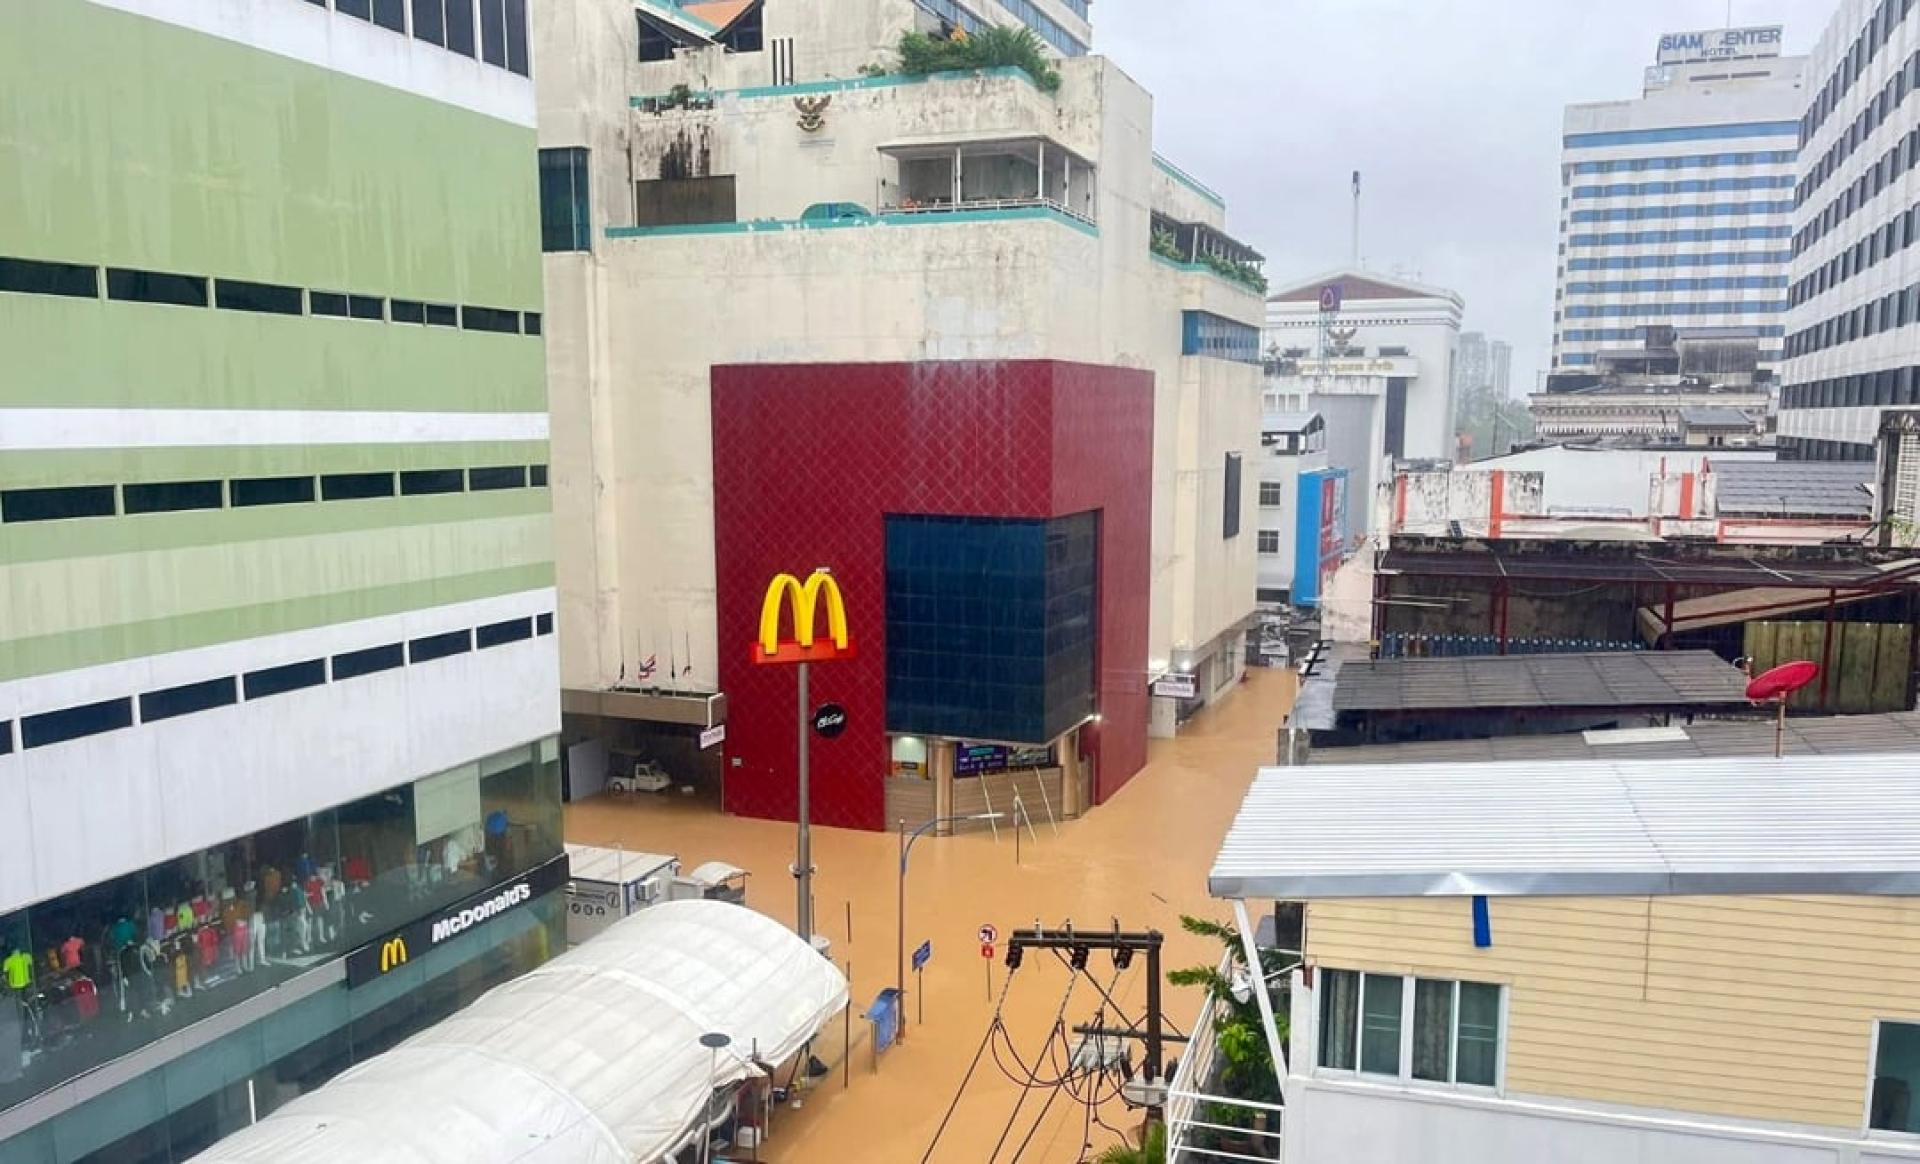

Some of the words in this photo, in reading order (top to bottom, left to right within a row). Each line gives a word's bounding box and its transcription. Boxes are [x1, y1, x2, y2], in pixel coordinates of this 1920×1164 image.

[1661, 33, 1703, 50] SIAM
[1720, 29, 1781, 46] ENTER
[1701, 47, 1737, 57] HOTEL
[431, 883, 531, 943] McDonald's
